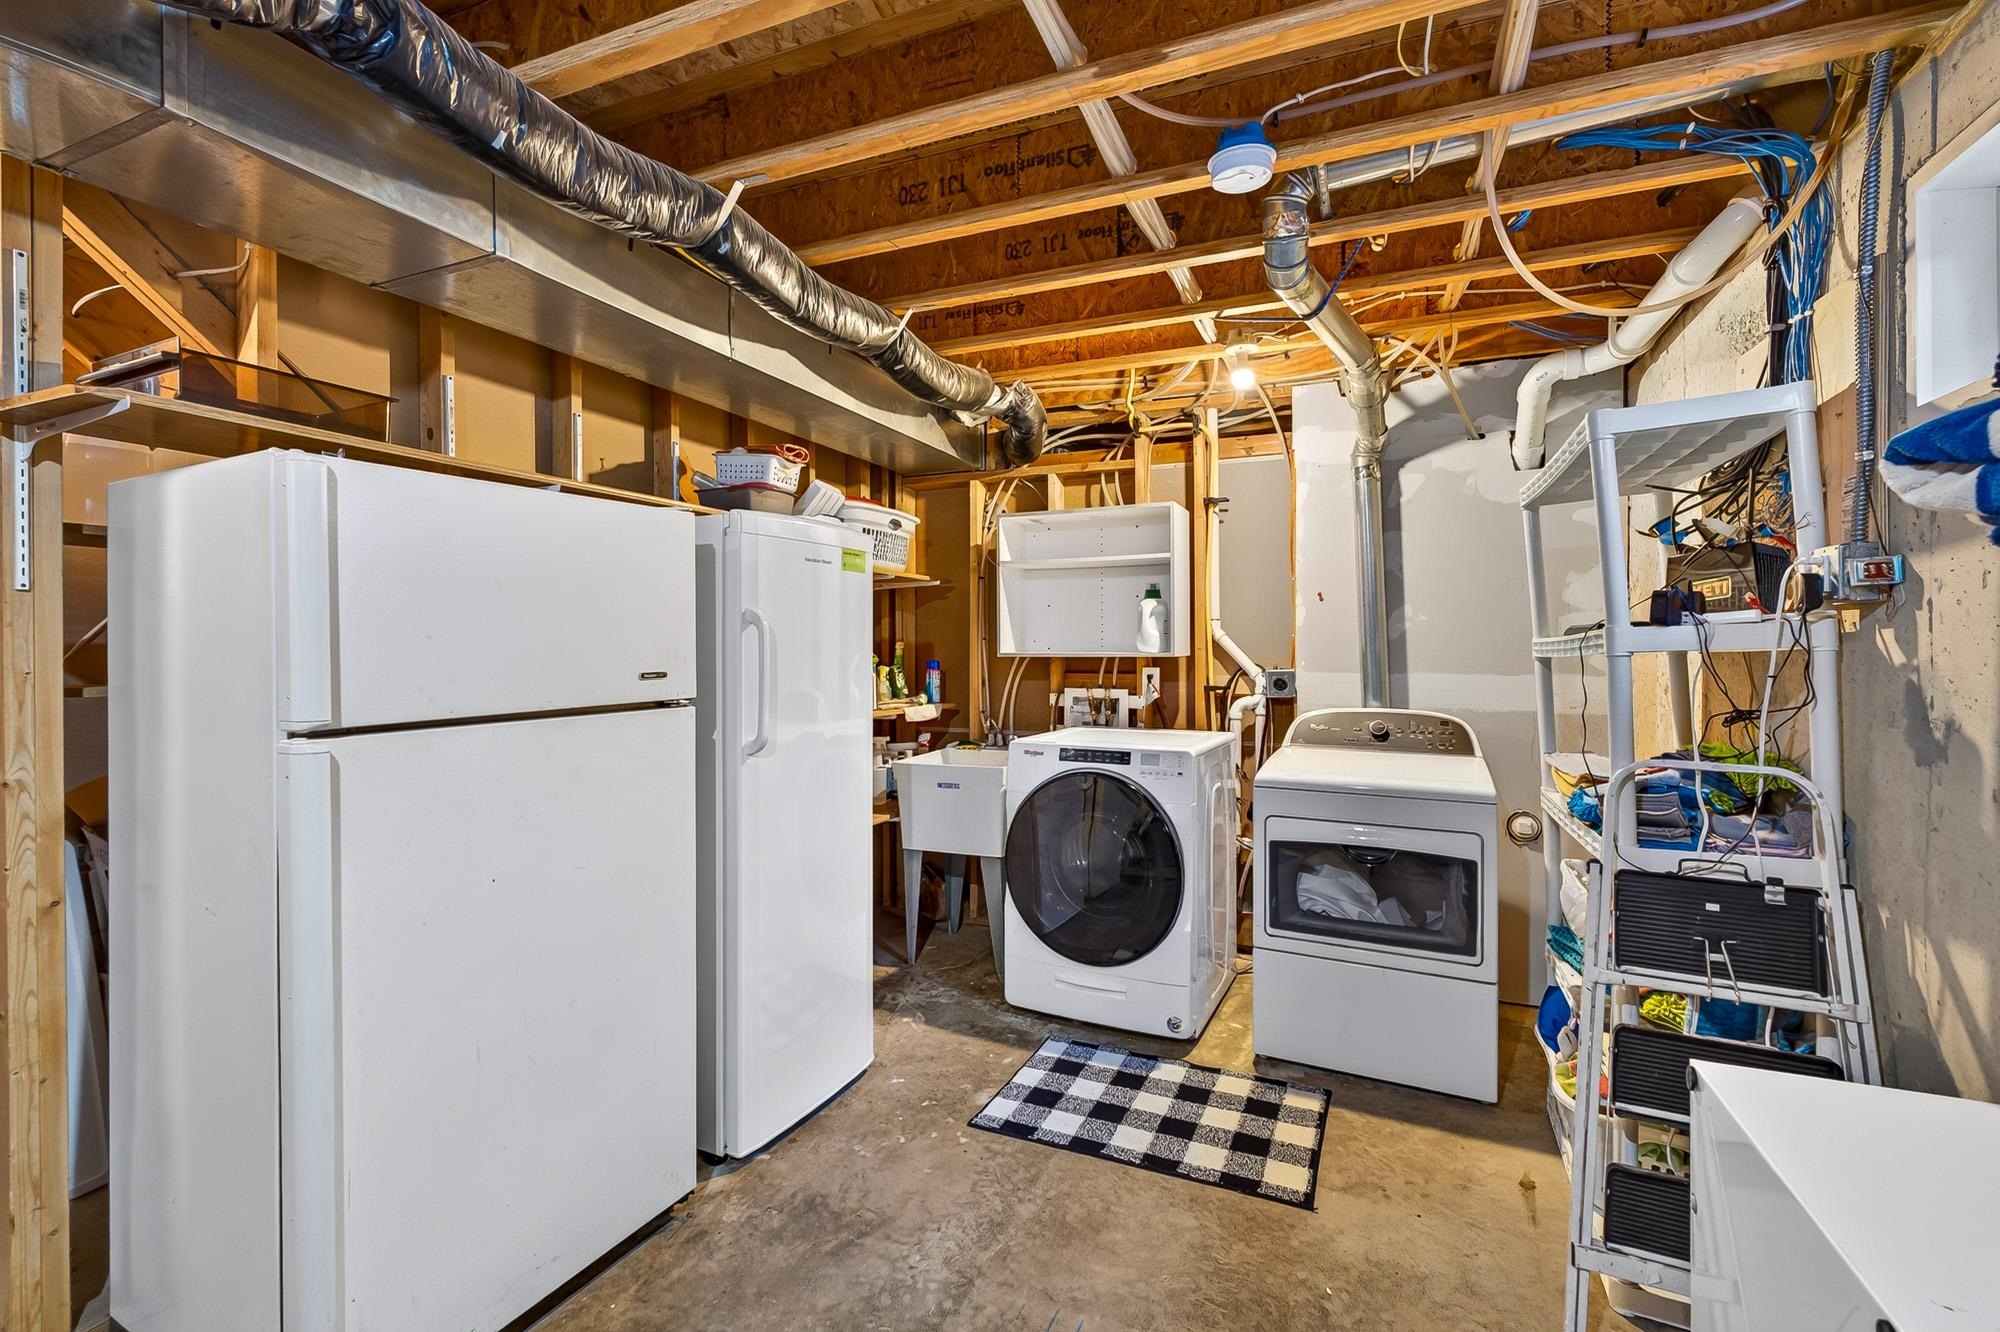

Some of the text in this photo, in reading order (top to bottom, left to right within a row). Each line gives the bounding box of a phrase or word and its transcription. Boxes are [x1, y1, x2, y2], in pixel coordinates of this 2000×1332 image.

[899, 181, 928, 207] 230
[939, 172, 968, 198] TJI
[1005, 238, 1032, 261] 230
